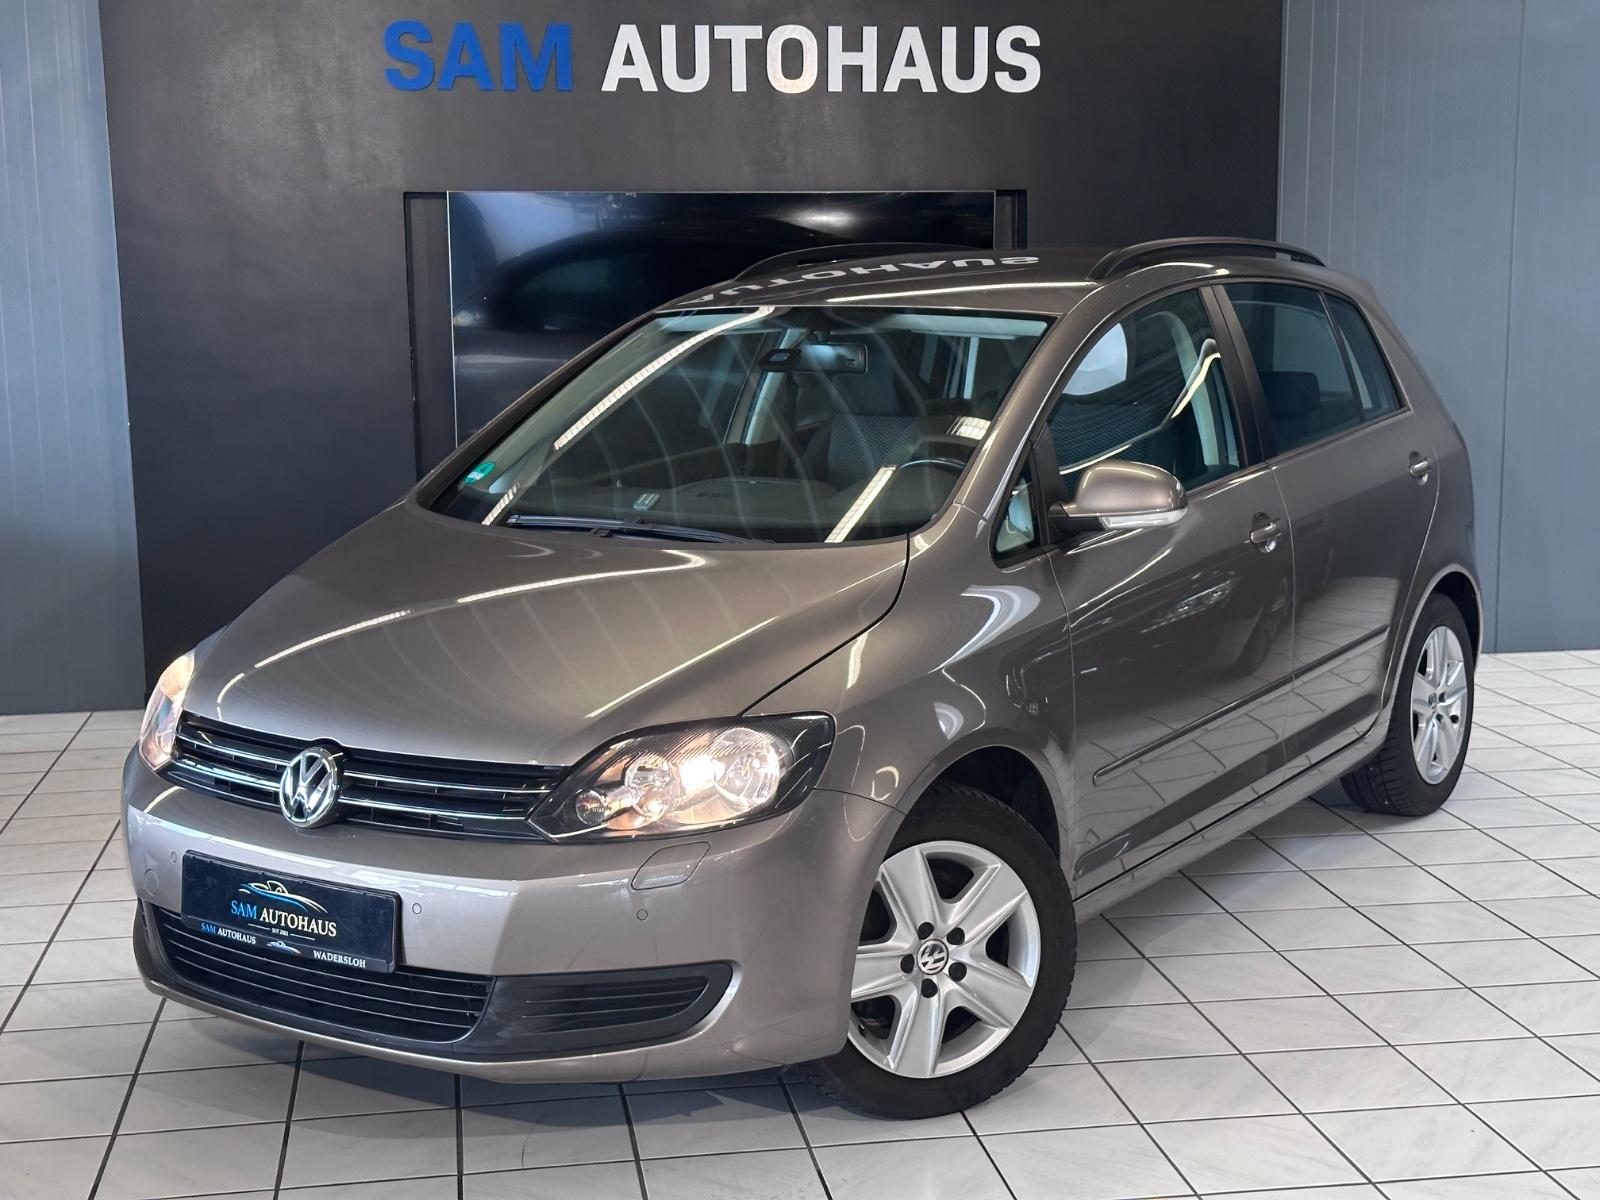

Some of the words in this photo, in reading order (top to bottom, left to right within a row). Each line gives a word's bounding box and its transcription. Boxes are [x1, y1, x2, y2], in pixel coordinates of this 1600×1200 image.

[384, 20, 574, 92] SAM
[601, 24, 1042, 94] AUTOHAUS
[201, 922, 216, 934] SAM
[217, 927, 257, 945] AUTOHAUS
[231, 900, 257, 919] SAM
[259, 909, 337, 937] AUTOHAUS
[313, 950, 366, 968] WADERSLOH
